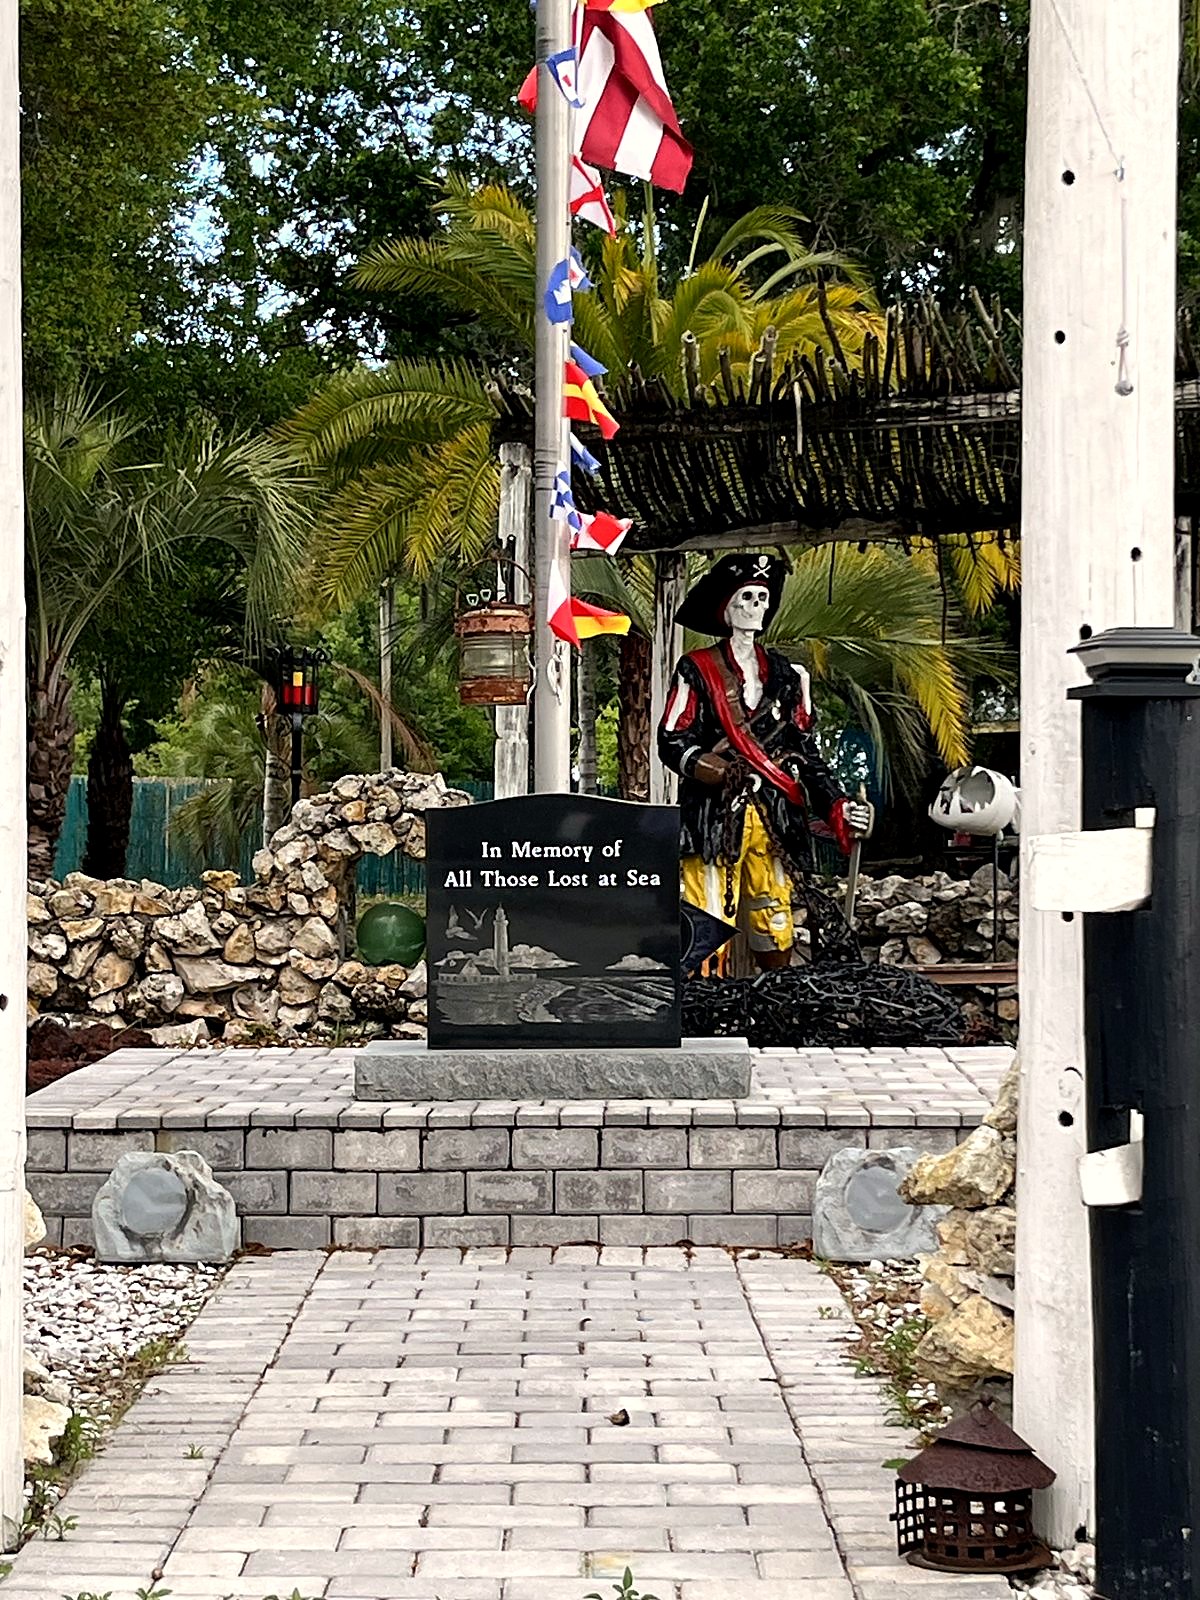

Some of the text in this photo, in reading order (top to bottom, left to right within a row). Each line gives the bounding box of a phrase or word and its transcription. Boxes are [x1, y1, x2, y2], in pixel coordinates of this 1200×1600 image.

[481, 839, 623, 863] In Memory of
[443, 869, 661, 888] All Those Lost at Sea
